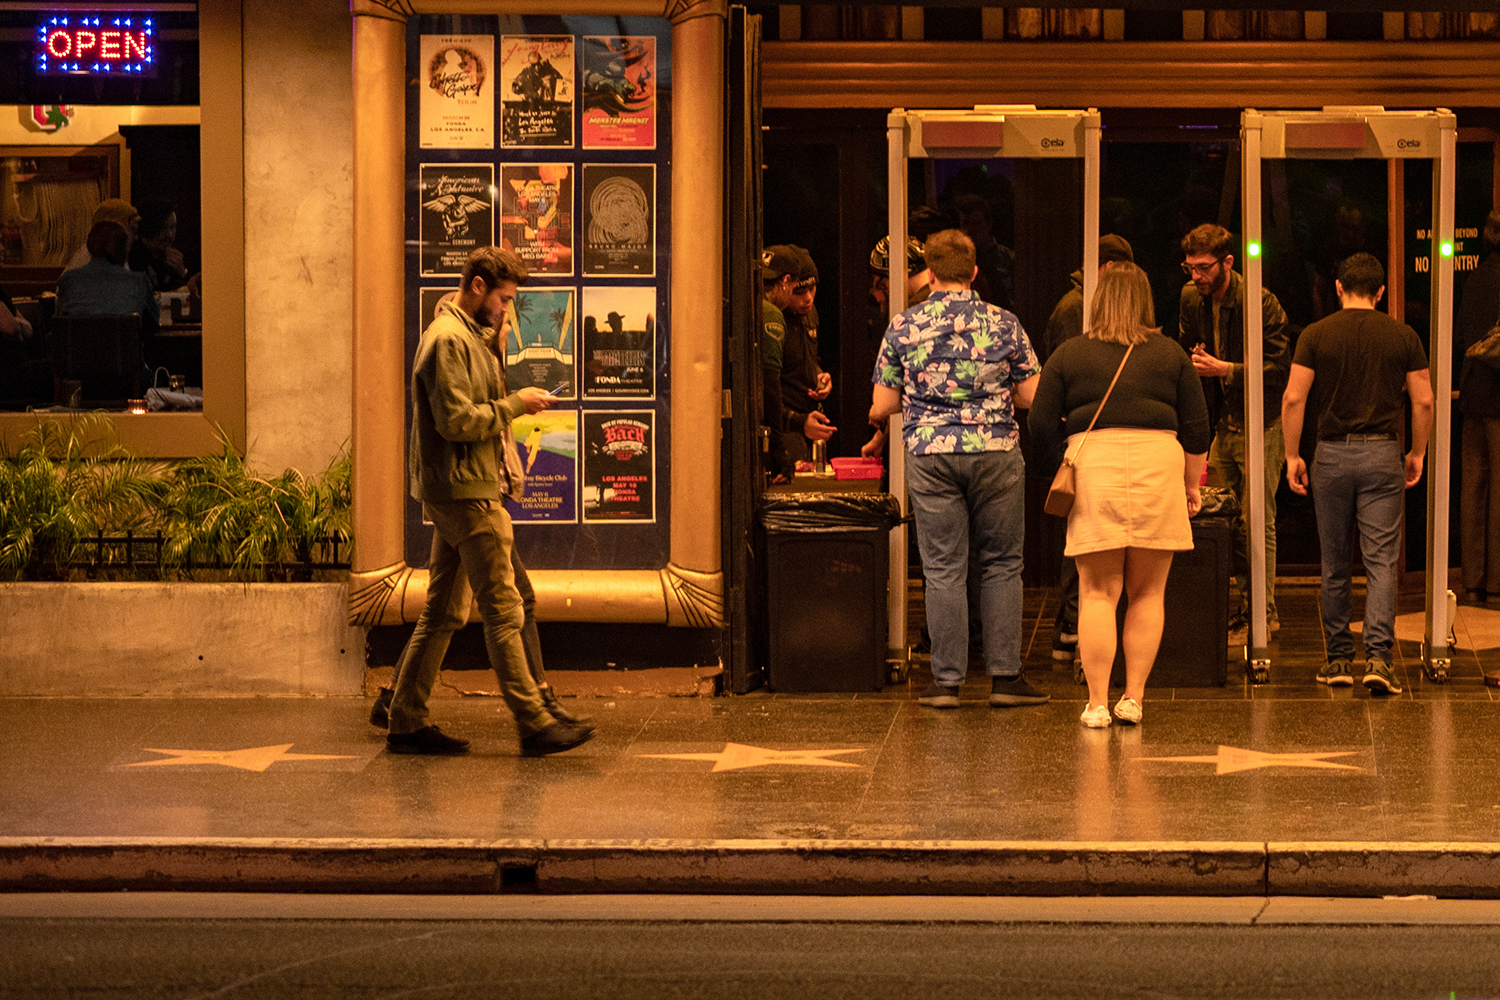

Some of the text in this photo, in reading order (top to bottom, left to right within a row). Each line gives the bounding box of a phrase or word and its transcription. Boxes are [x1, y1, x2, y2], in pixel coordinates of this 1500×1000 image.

[48, 31, 146, 59] OPEN
[588, 117, 650, 126] MONSTER MAGNET
[1416, 228, 1478, 240] NO BEYOND
[1415, 256, 1429, 273] NO
[597, 376, 621, 384] FONDA
